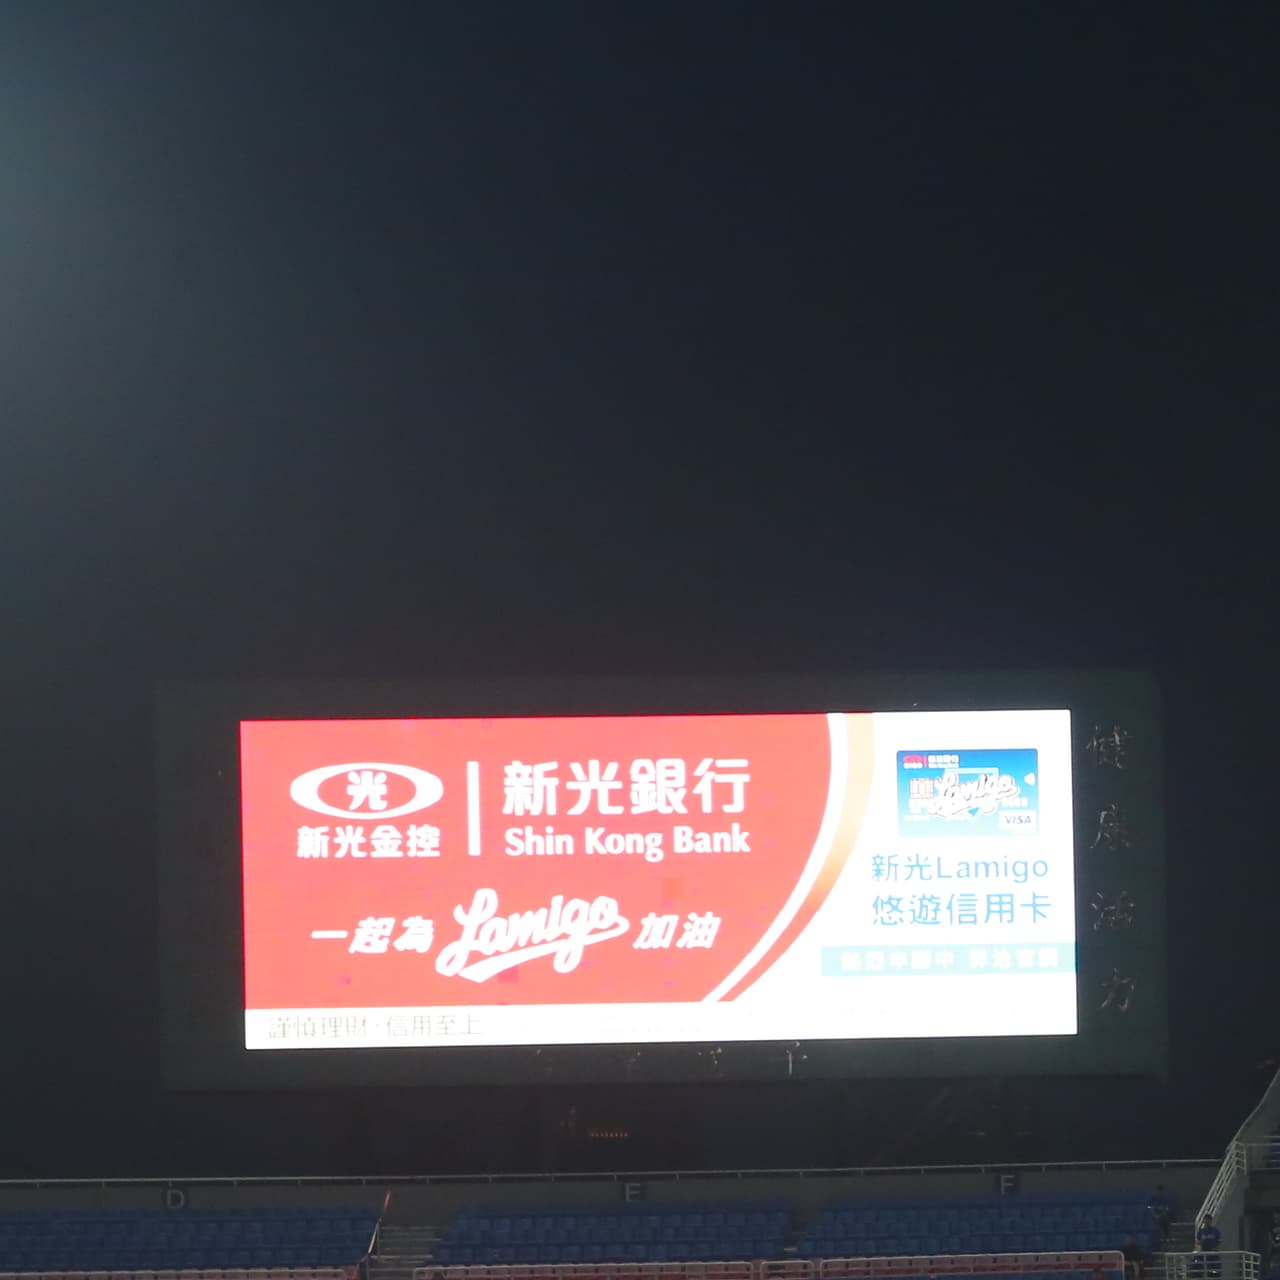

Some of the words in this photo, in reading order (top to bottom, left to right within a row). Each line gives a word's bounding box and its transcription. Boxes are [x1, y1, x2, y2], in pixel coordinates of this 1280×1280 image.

[502, 758, 751, 816] 新光銀行
[296, 824, 441, 859] 新光金控
[504, 827, 574, 857] Shin
[585, 826, 665, 863] Kong
[673, 823, 751, 854] Bank
[871, 853, 1050, 884] 新光Lamigo
[871, 891, 1052, 926] 悠遊信用卡
[311, 915, 435, 954] 一起為
[435, 888, 630, 983] Lamigo
[632, 911, 721, 950] 加油
